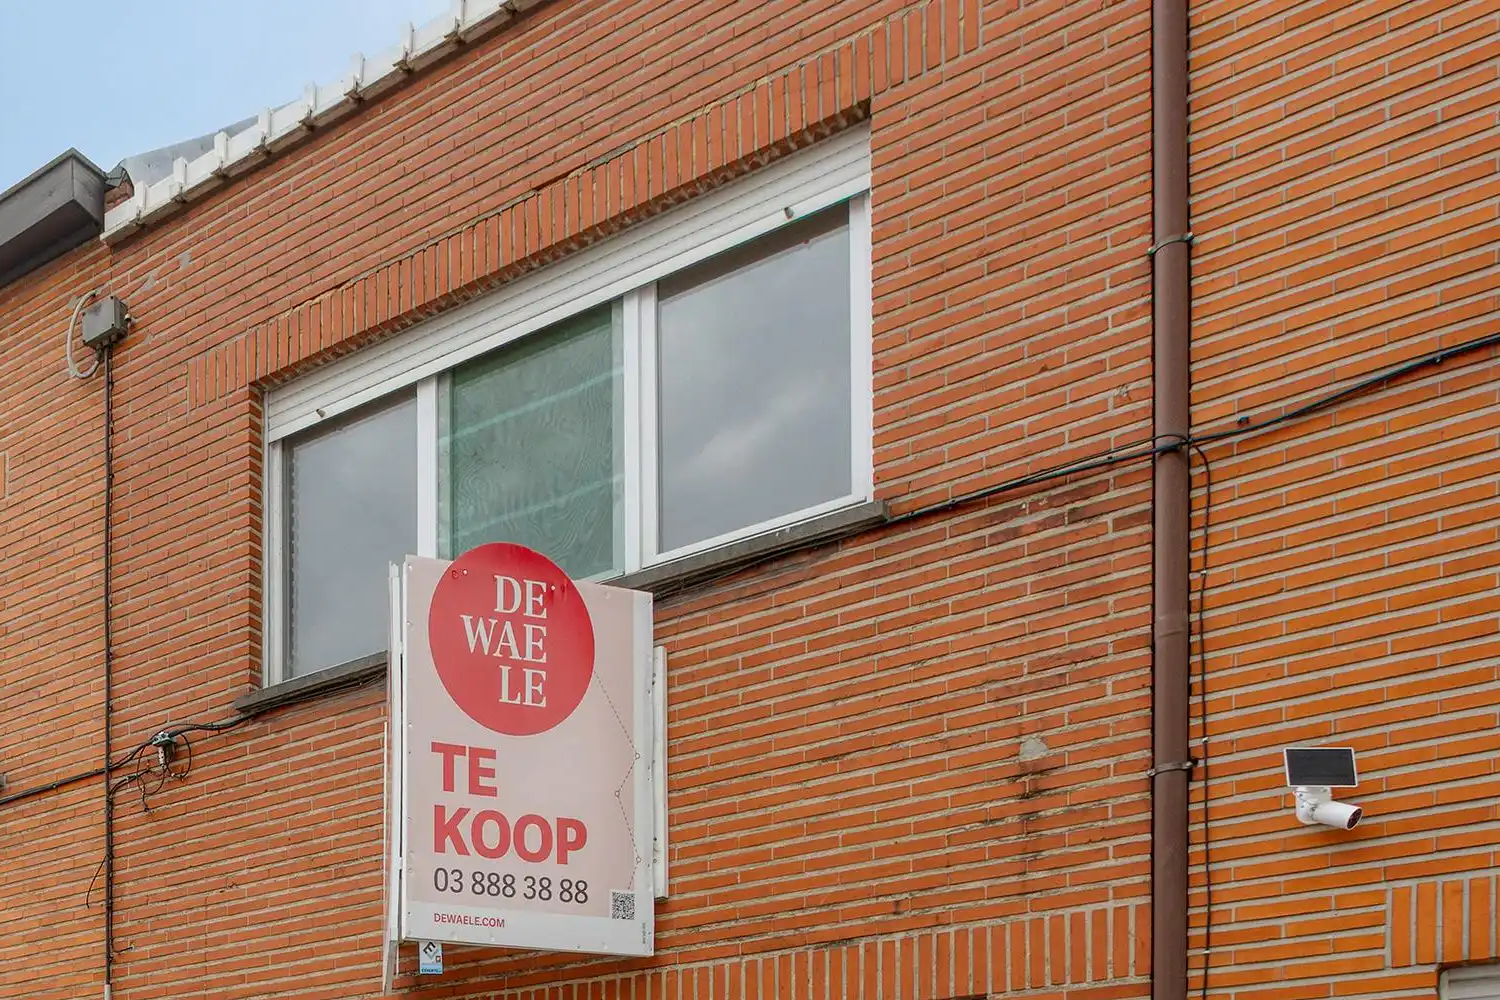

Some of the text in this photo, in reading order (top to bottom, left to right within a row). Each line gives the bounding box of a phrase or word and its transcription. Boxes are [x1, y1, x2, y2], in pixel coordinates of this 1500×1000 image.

[494, 574, 547, 619] DE
[460, 614, 547, 664] WAE
[498, 665, 547, 708] LE
[431, 741, 497, 798] TE
[433, 804, 588, 865] KOOP
[433, 867, 588, 904] 03 888 38 88
[434, 913, 505, 928] DEWAELE.COM
